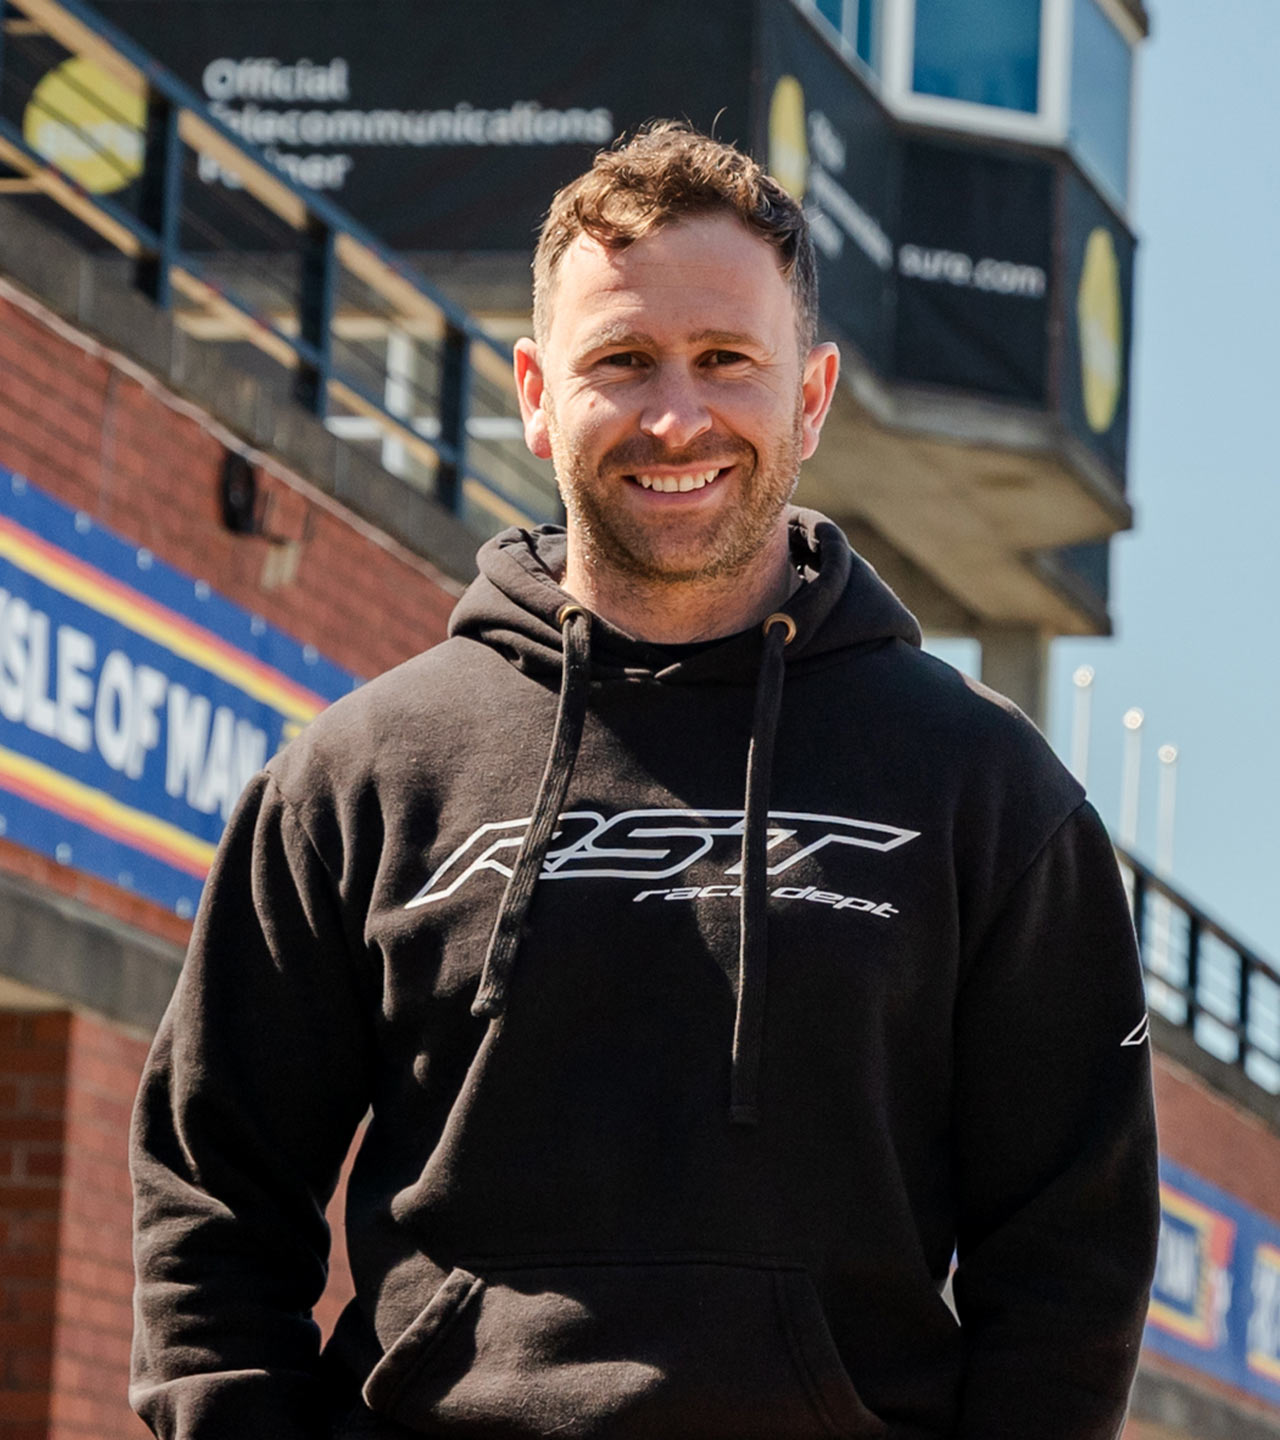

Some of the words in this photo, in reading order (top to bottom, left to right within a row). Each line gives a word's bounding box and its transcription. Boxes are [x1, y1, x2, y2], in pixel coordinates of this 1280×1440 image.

[202, 56, 349, 101] Official
[210, 101, 613, 146] lecommunications
[94, 651, 169, 781] OF
[165, 682, 267, 824] MAN
[405, 809, 921, 909] RST
[771, 885, 900, 918] dept
